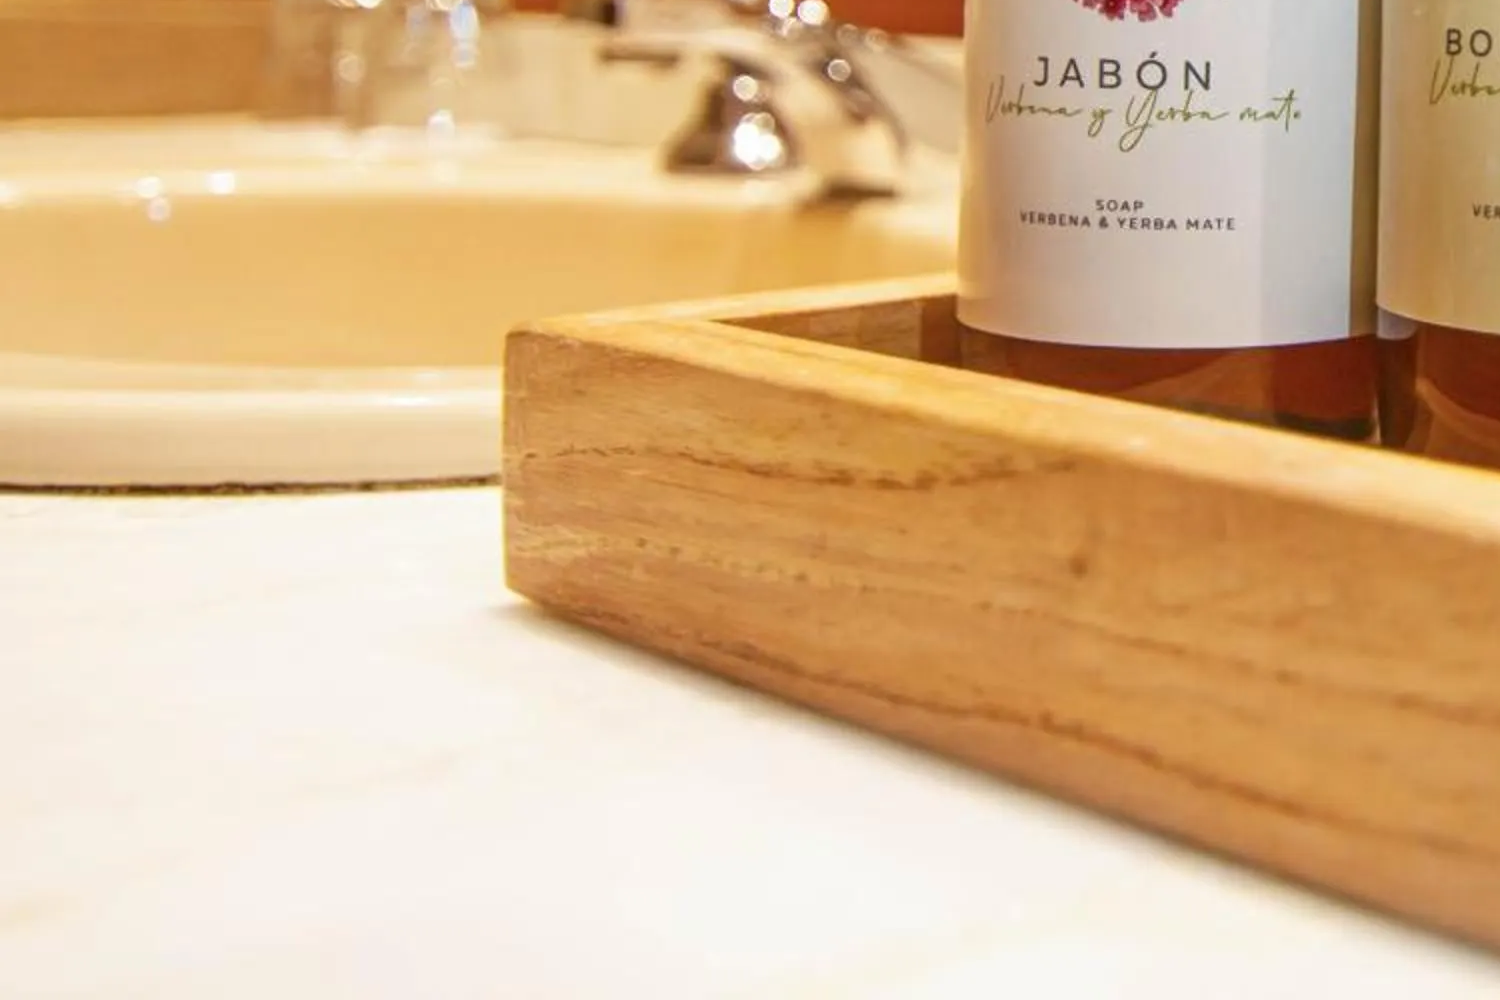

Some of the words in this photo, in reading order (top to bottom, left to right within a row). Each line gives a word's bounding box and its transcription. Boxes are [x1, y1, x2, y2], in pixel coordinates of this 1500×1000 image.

[1032, 52, 1212, 91] JABÓN
[1118, 88, 1231, 153] Yerba
[1020, 210, 1092, 228] VERBENA
[1098, 217, 1109, 229] &
[1117, 217, 1178, 231] YERBA
[1185, 217, 1237, 231] MATE
[1095, 198, 1145, 213] SOAP
